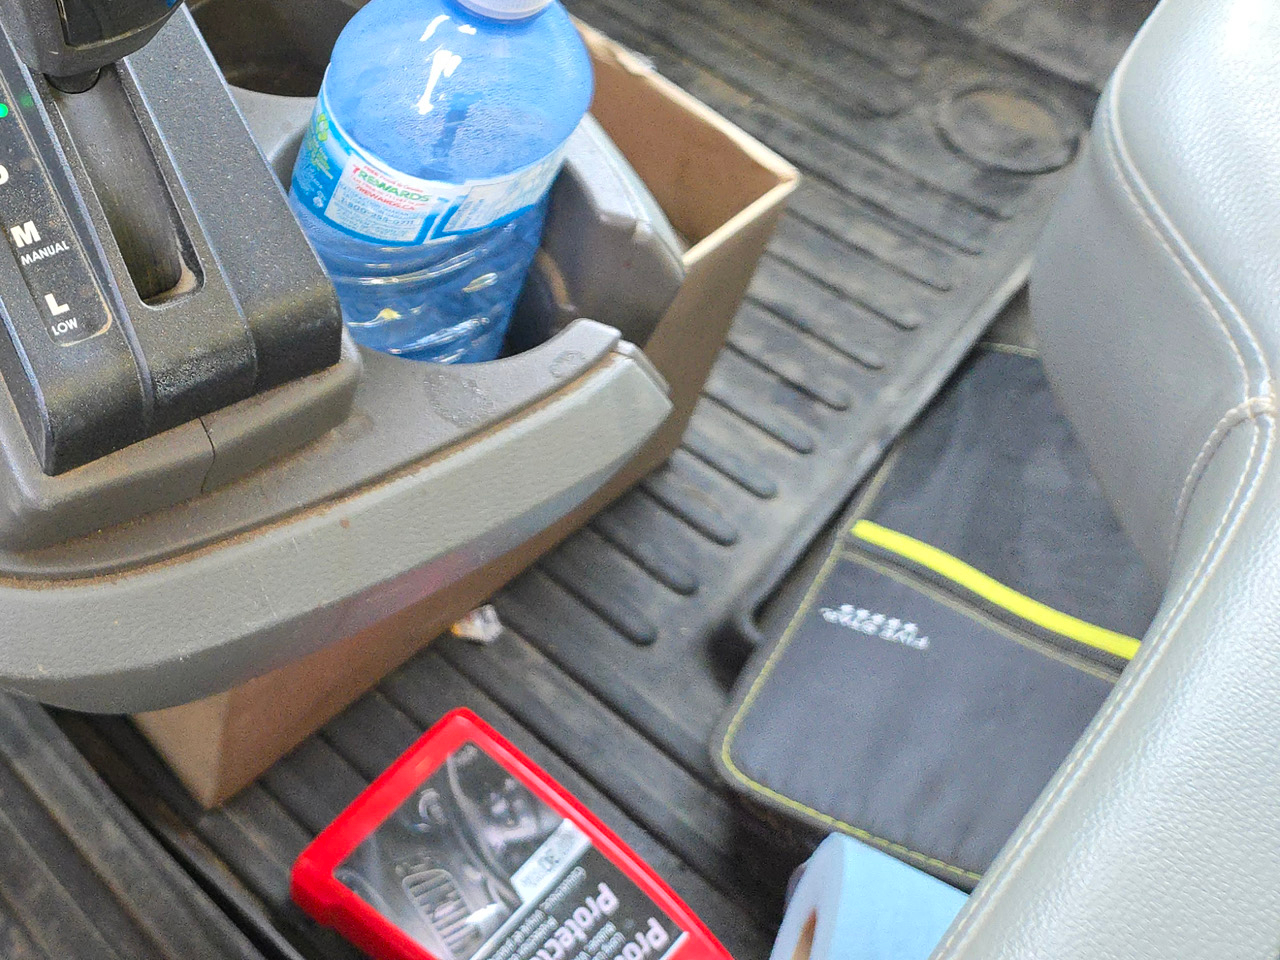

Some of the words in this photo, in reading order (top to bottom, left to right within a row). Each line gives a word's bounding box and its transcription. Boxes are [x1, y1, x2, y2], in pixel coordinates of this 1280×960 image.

[10, 220, 41, 248] M
[20, 240, 70, 266] MANUAL
[44, 293, 70, 316] L
[51, 317, 78, 336] LOW
[613, 916, 670, 960] Pro
